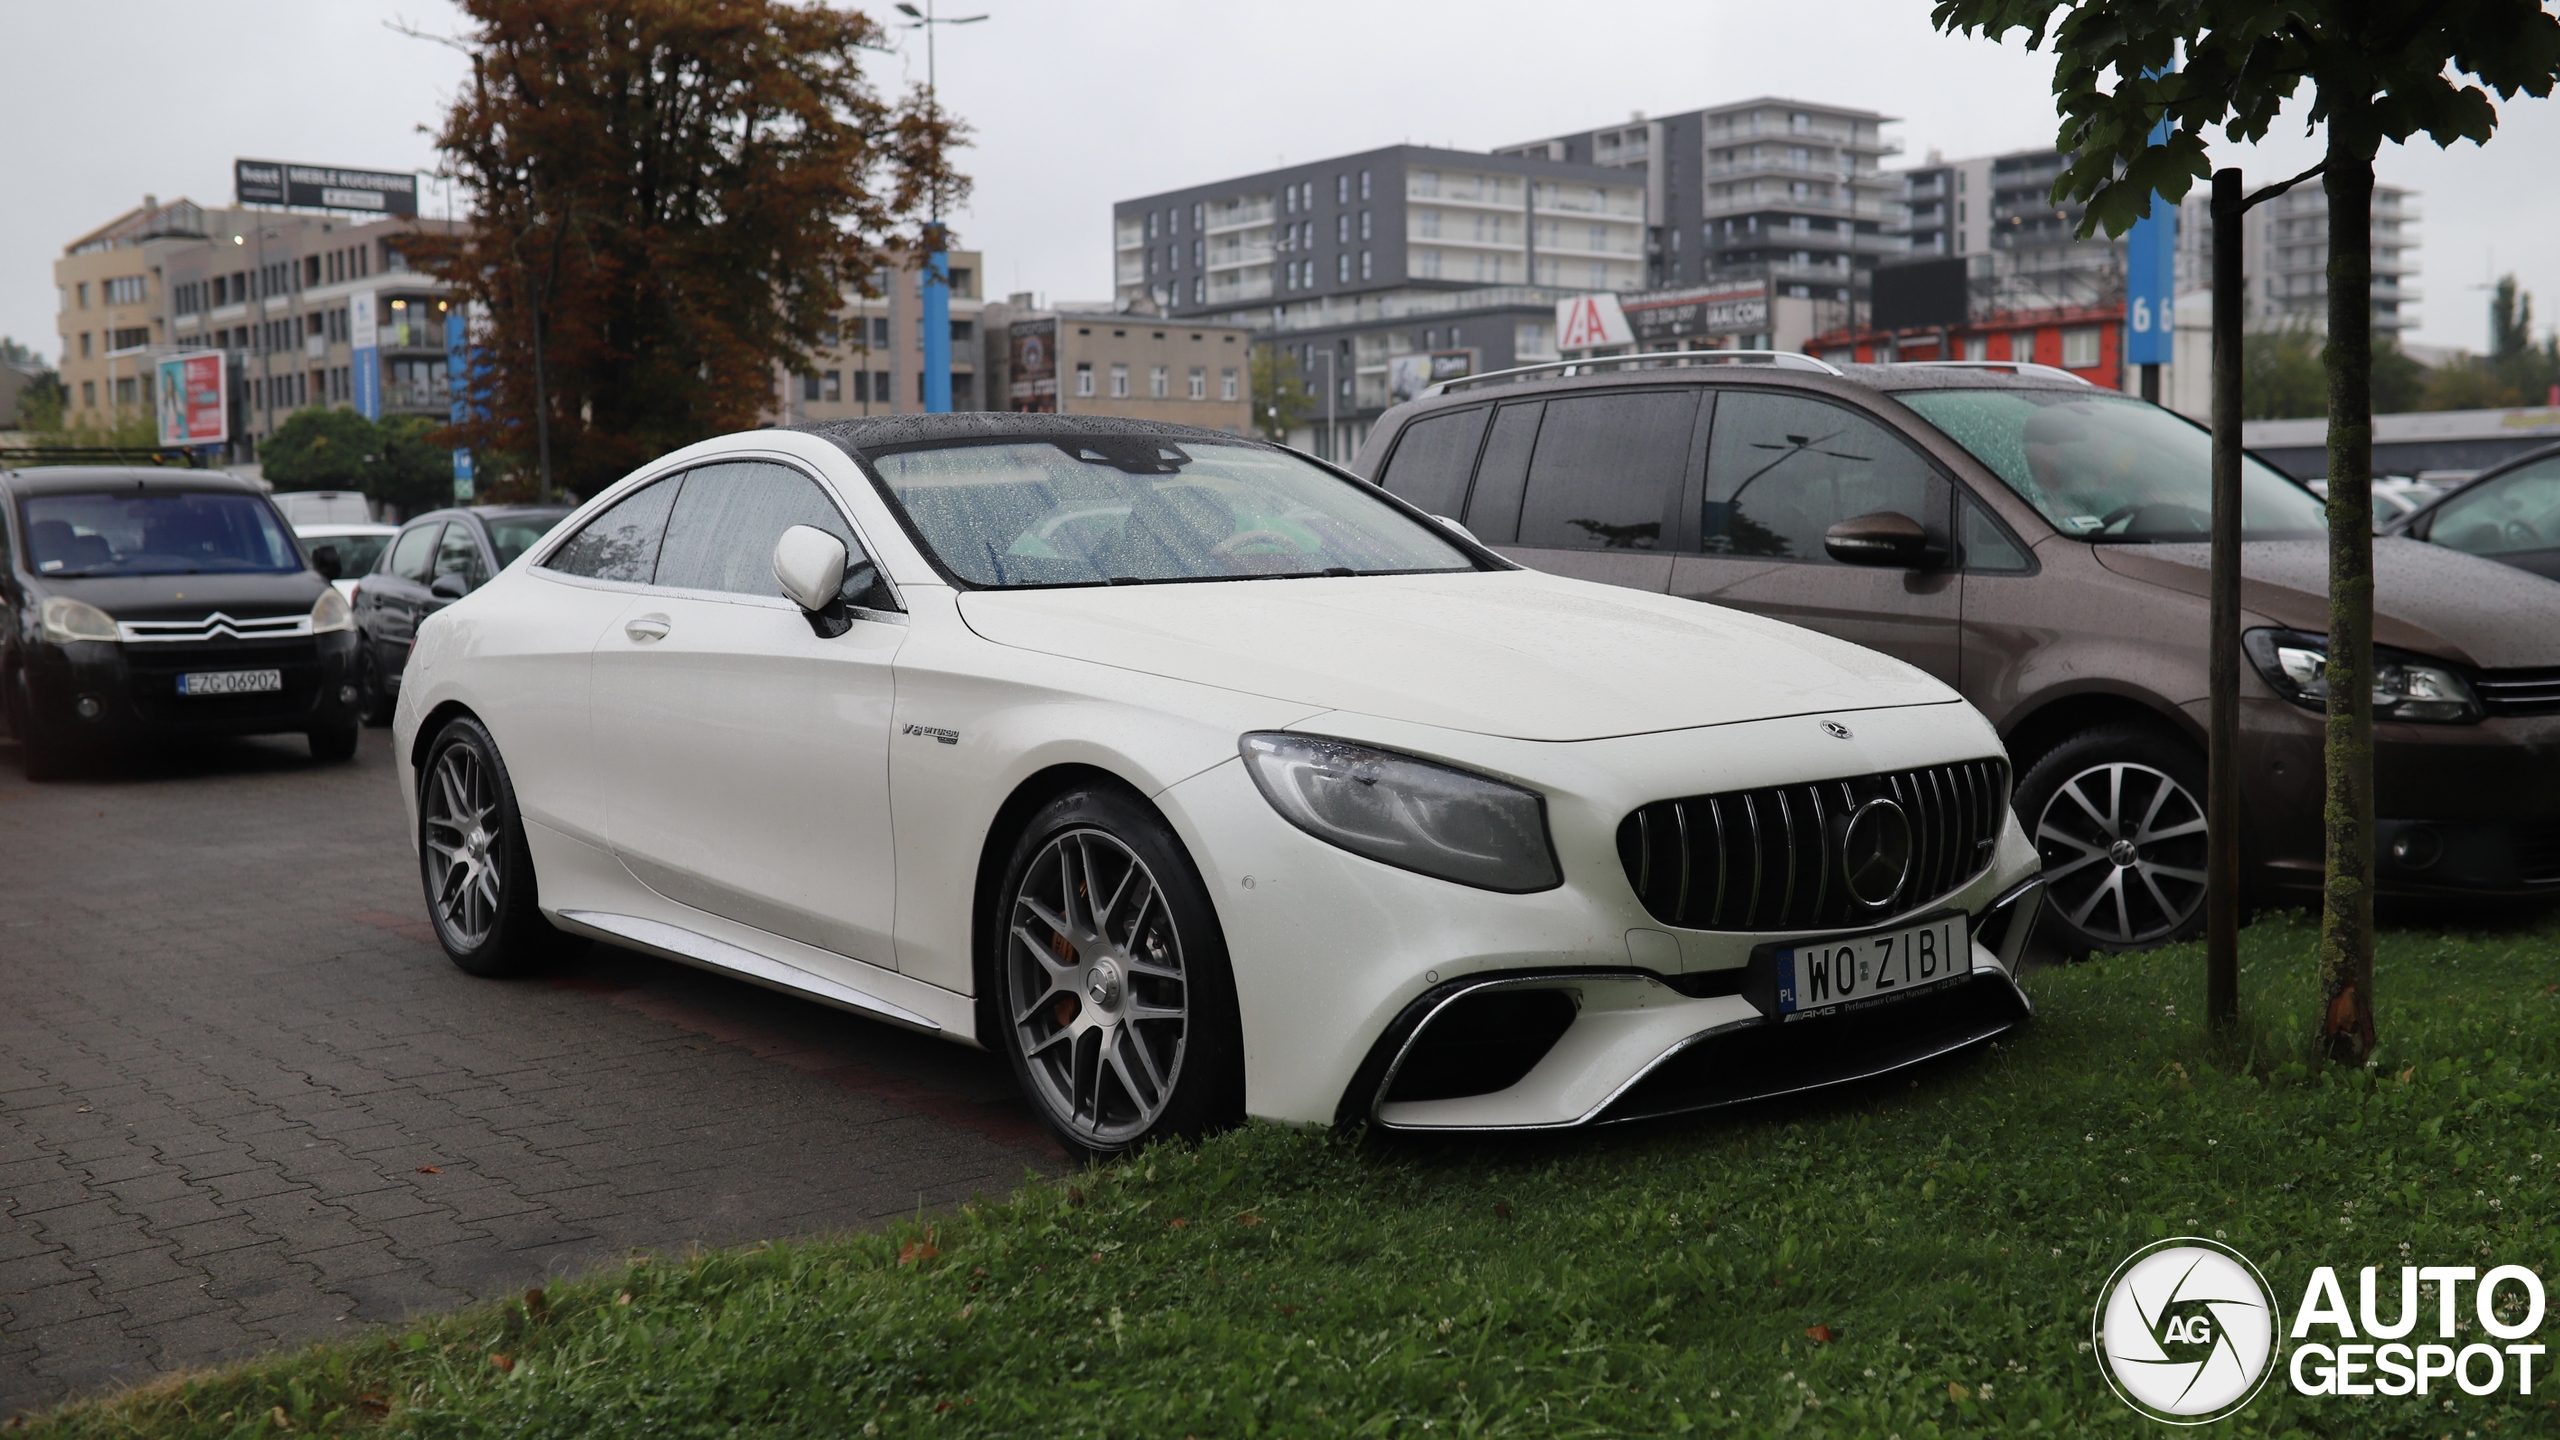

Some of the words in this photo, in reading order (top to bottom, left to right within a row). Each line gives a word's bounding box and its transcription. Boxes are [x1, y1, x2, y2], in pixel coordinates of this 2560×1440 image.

[289, 165, 338, 186] MEBLE
[339, 171, 413, 193] KUCHENNE
[2133, 296, 2151, 333] 6
[2161, 297, 2172, 333] 6
[187, 674, 220, 694] EZG
[226, 671, 279, 692] 06902
[903, 723, 923, 736] V8
[1807, 945, 1856, 1003] WO
[1874, 922, 1951, 990] ZIBI
[1780, 988, 1794, 1003] PL
[1844, 997, 1885, 1012] Performance
[1885, 993, 1905, 1004] Center
[1905, 986, 1933, 998] Warszawa
